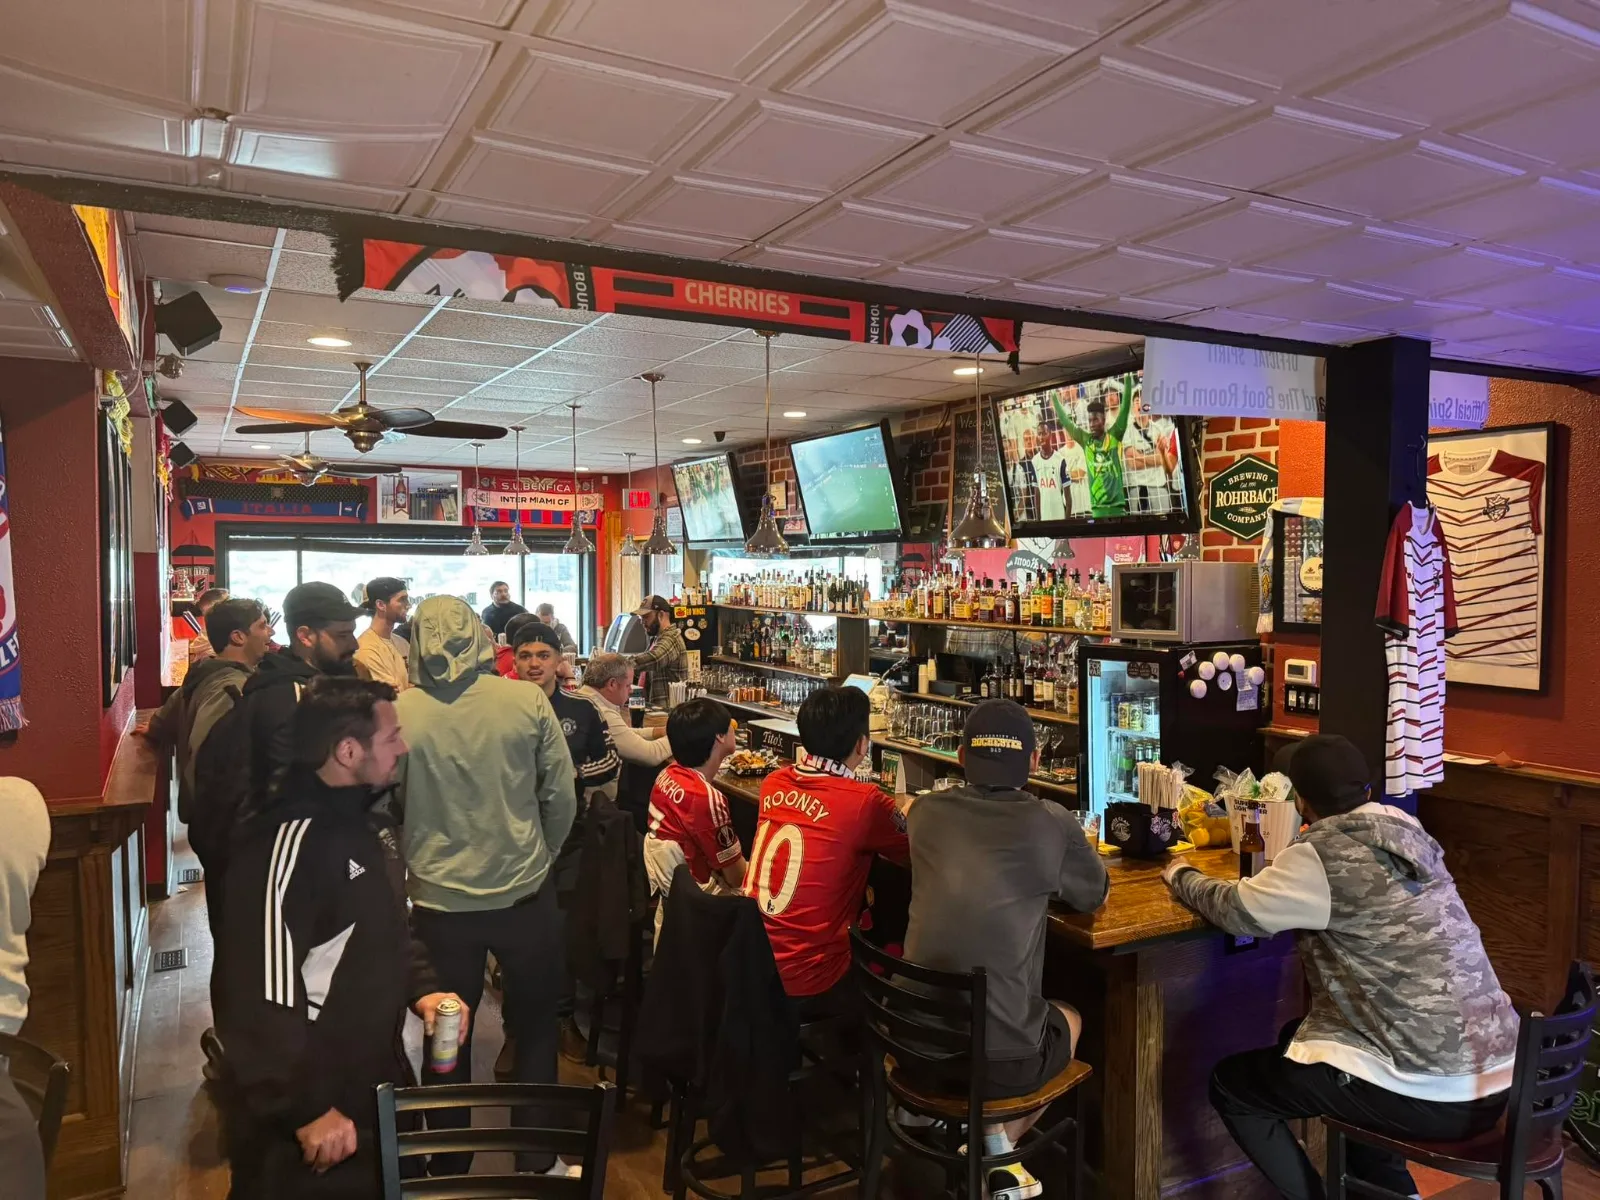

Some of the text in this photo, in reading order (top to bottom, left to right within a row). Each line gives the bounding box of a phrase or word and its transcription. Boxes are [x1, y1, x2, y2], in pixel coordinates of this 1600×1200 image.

[684, 281, 790, 316] CHERRIES
[1040, 477, 1057, 489] AIA
[1227, 471, 1268, 485] BREWING
[500, 495, 570, 507] INTER MIAMI CF
[1215, 486, 1279, 508] ROHRBACH
[241, 502, 313, 514] ITALIA
[1227, 510, 1268, 524] COMPANY
[970, 737, 1023, 751] ROCHESTER
[763, 789, 830, 824] ROONEY
[349, 866, 367, 880] adidas
[744, 818, 804, 917] 10
